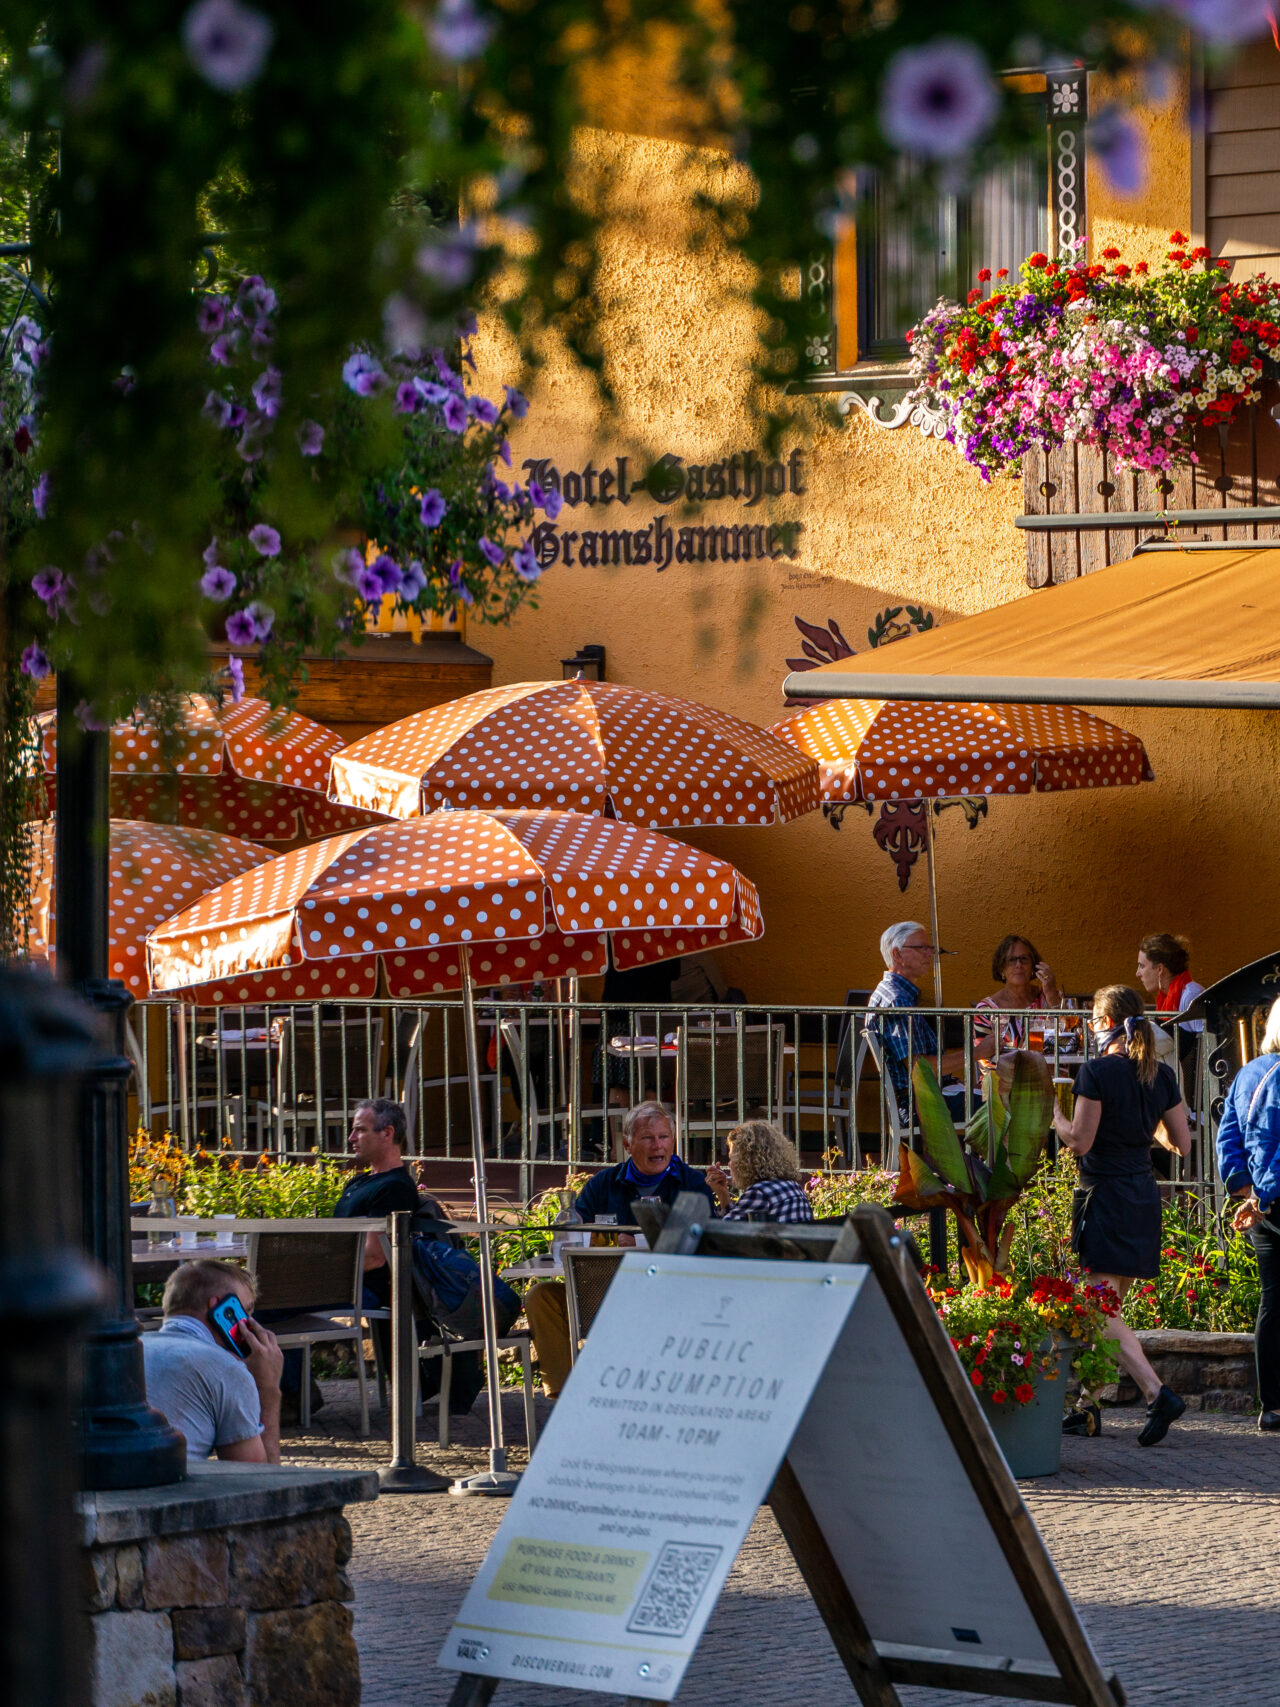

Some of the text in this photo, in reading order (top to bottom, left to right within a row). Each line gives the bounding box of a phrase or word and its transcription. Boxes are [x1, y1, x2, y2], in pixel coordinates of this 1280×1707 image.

[522, 447, 805, 508] Hotel-Gasthof
[527, 515, 805, 573] Gramshammer
[659, 1336, 754, 1362] PUBLIC
[597, 1366, 785, 1399] CONSUMPTION
[588, 1397, 772, 1420] PERMITTED IN DESIGNATED AREAS
[618, 1422, 664, 1441] 10AM
[676, 1427, 721, 1446] 10PM
[516, 1544, 564, 1558] PURCHASE
[565, 1549, 593, 1561] FOOD
[602, 1554, 636, 1566] DRINKS
[456, 1645, 479, 1661] VAIL
[512, 1655, 612, 1677] DISCOVERVAIL.COM
